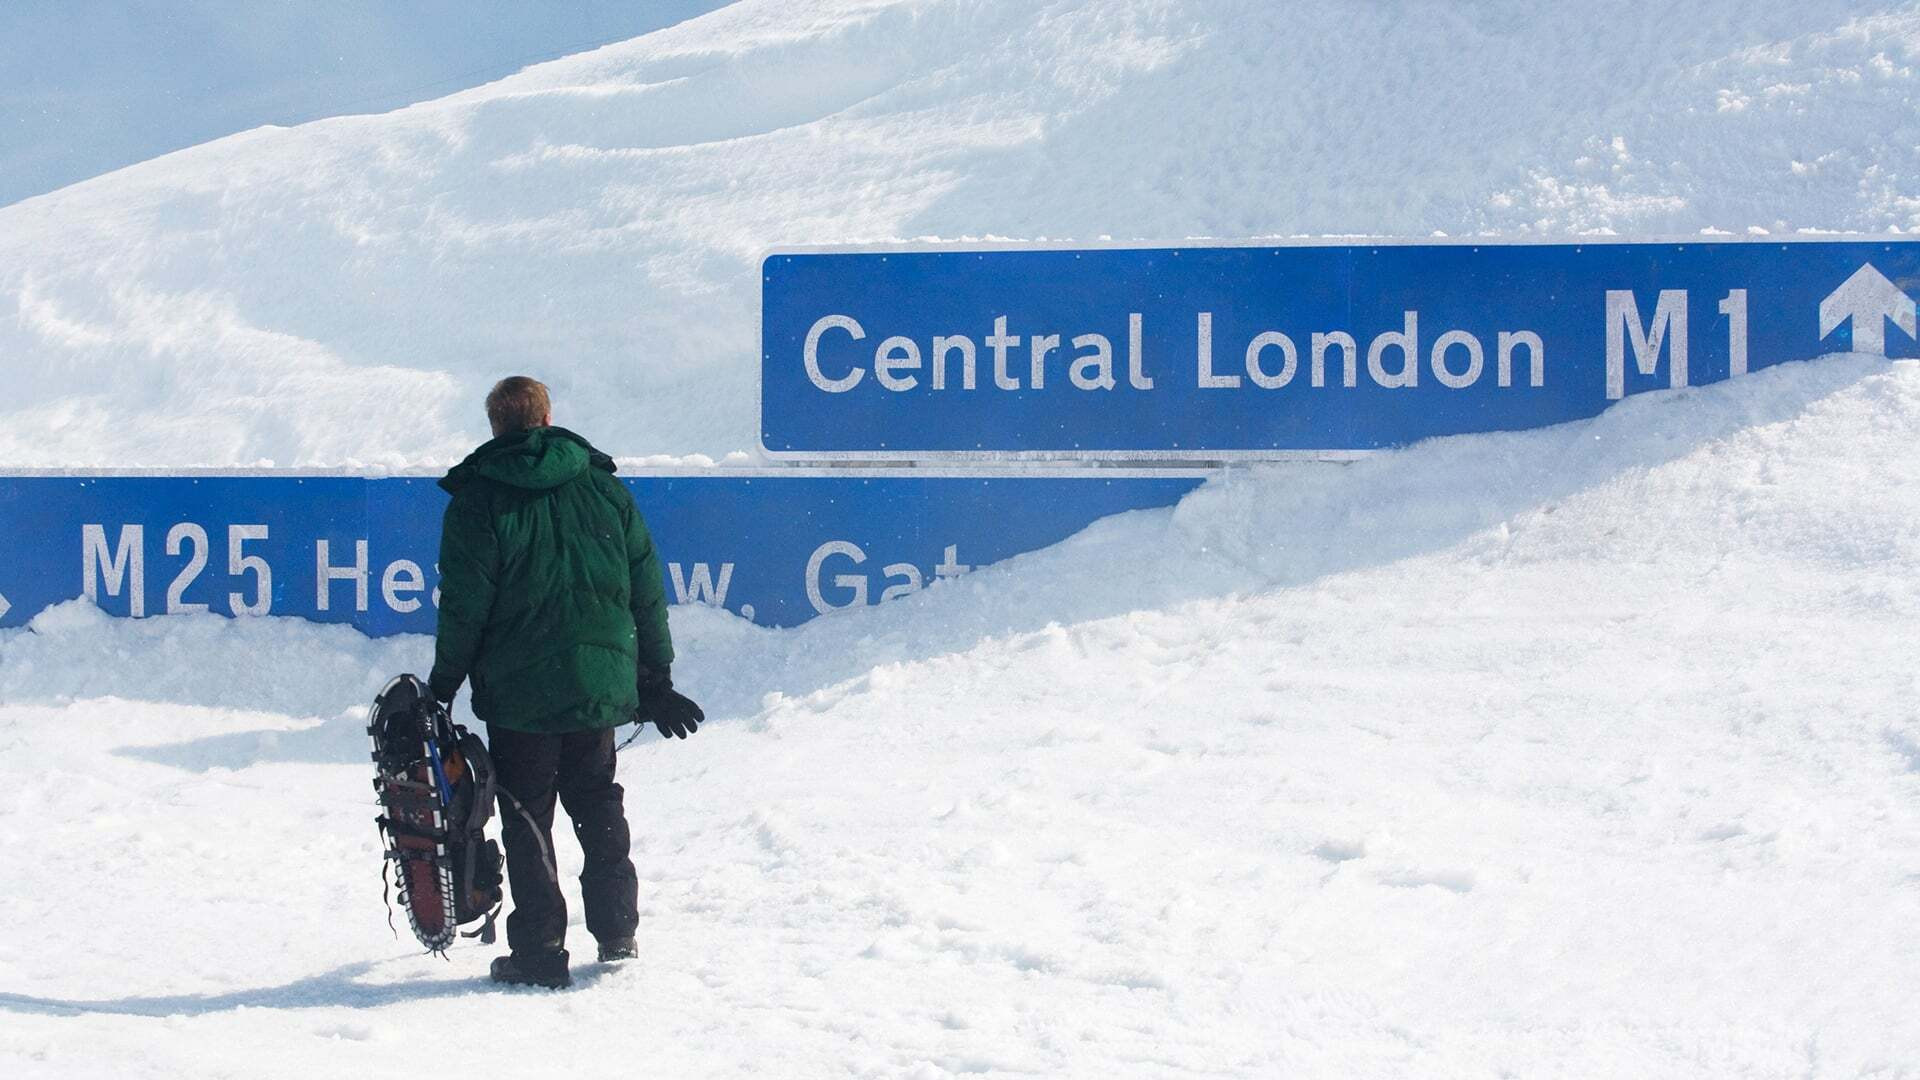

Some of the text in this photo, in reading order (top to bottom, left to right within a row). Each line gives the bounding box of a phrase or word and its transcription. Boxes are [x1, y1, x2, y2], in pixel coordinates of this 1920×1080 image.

[803, 288, 1748, 400] Central London M1
[82, 522, 272, 618] M25
